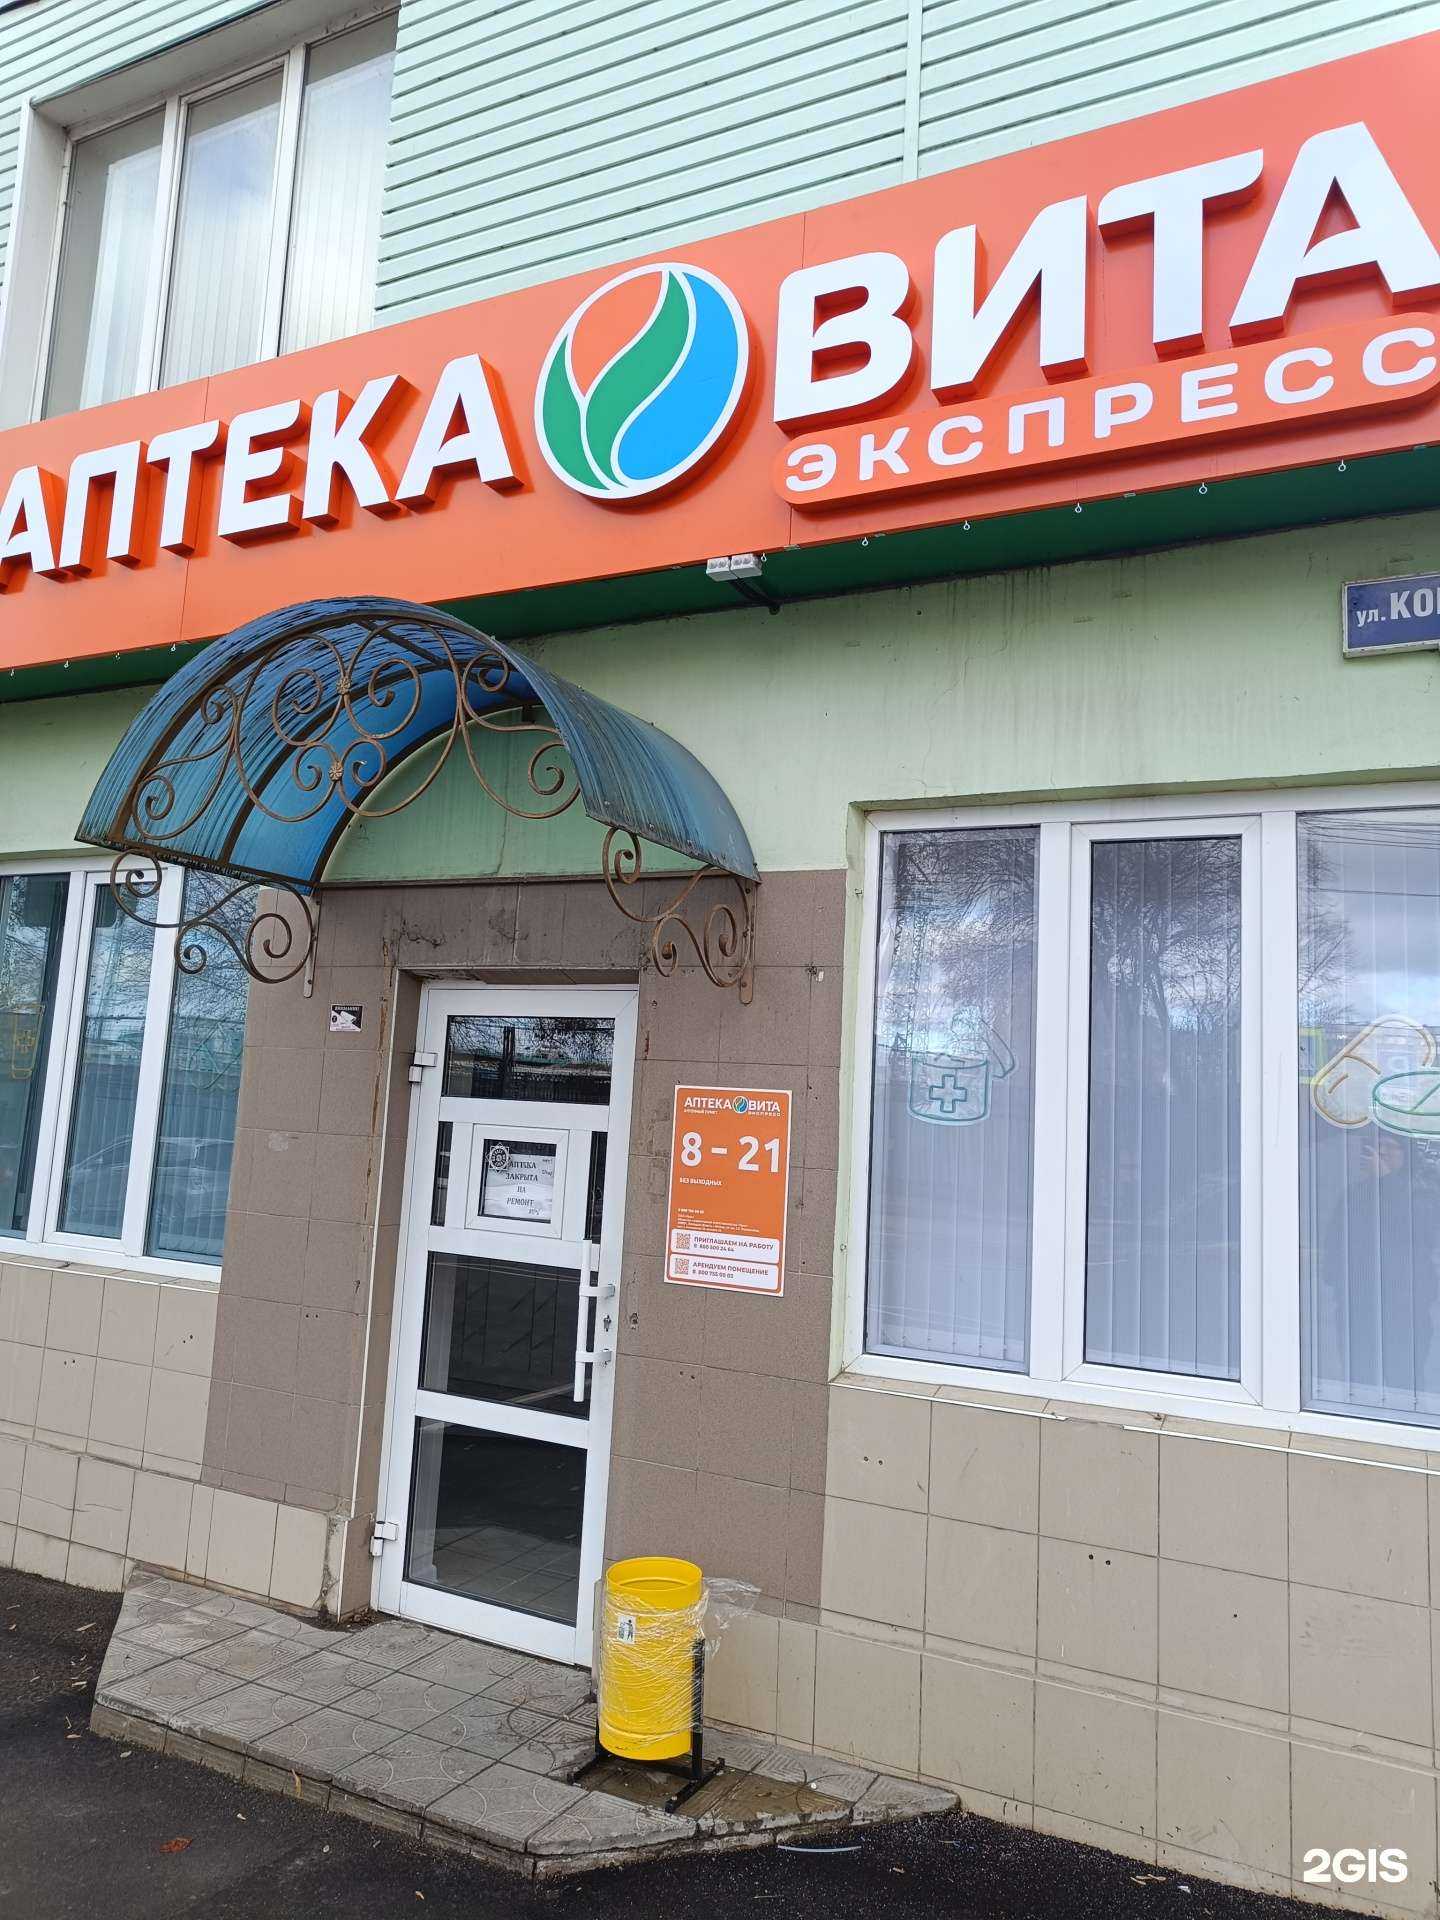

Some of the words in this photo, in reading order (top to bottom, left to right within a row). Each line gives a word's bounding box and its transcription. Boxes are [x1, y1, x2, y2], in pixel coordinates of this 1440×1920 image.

[0, 353, 516, 574] АПТЕКА
[774, 121, 1440, 423] ВИТА
[785, 327, 1438, 492] ЭКСПРЕСС
[1356, 608, 1386, 628] ул.
[1390, 587, 1440, 620] КО
[684, 1096, 732, 1110] АПТЕКА
[748, 1099, 781, 1112] ВИТА
[680, 1131, 702, 1167] 8
[738, 1135, 781, 1173] 21
[505, 1172, 538, 1181] ЗАКРЫТА
[506, 1197, 535, 1207] РЕМОНТ
[694, 1236, 737, 1247] ПРИГЛАШАЕМ
[748, 1242, 774, 1250] РАБОТУ
[692, 1261, 727, 1271] АРЕНДУЕМ
[727, 1266, 769, 1276] ПОМЕЩЕНИЕ
